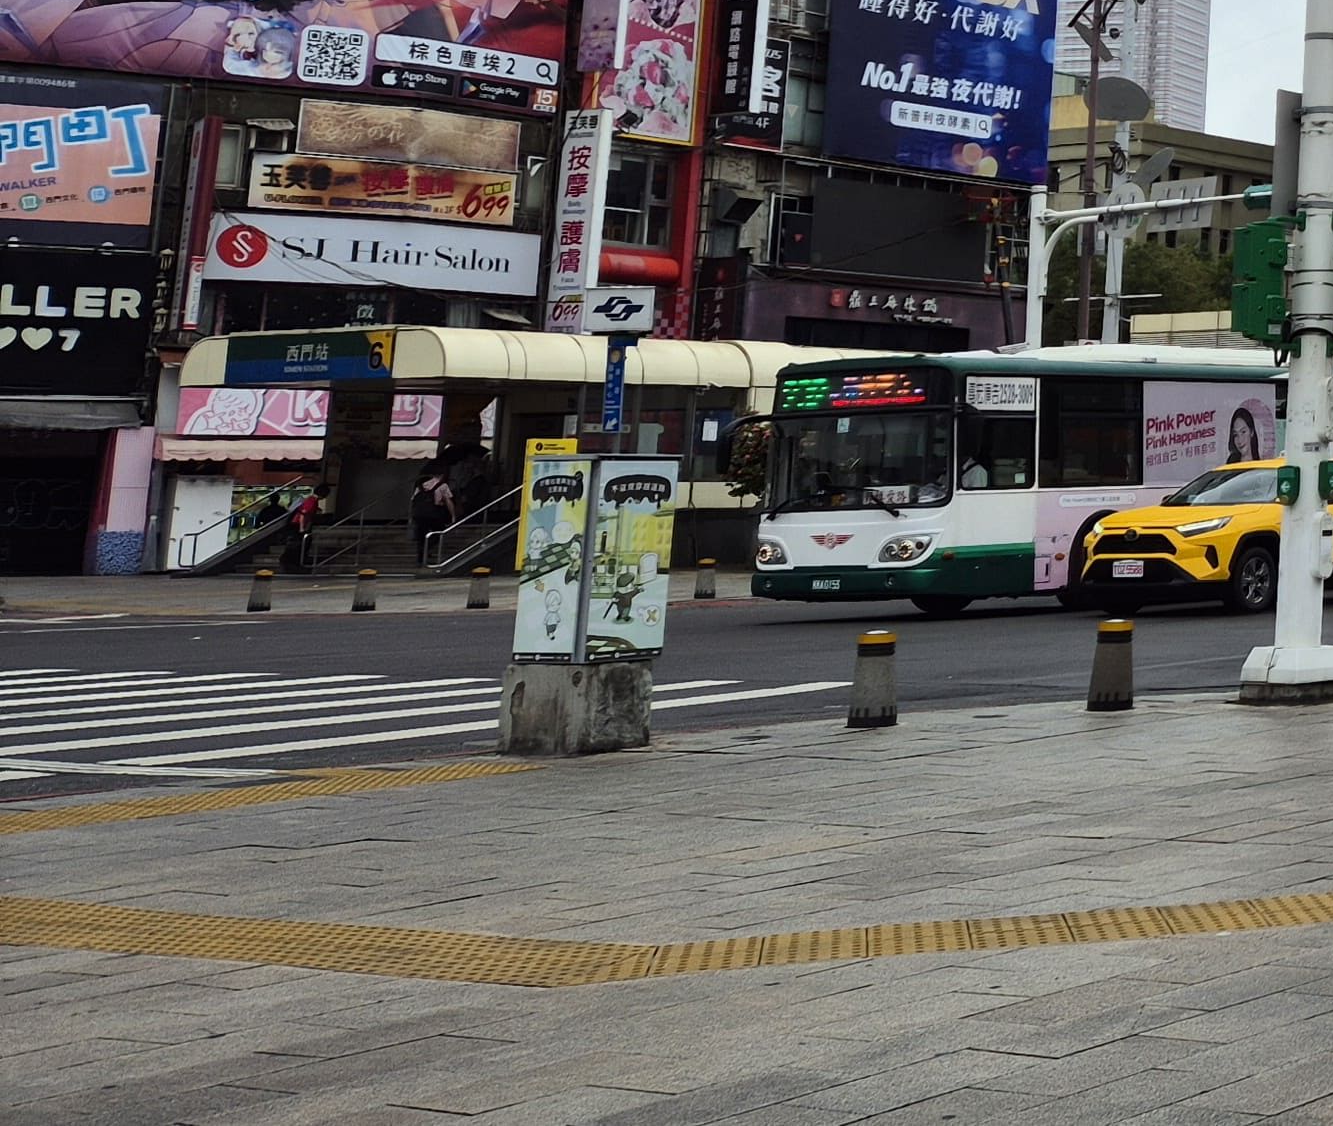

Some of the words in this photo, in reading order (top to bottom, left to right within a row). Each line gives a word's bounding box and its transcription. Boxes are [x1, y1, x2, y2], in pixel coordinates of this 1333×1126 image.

[408, 41, 516, 75] 棕色塵埃2
[402, 70, 424, 82] App
[425, 73, 448, 86] Store
[479, 82, 505, 95] Google
[505, 87, 521, 99] Play
[860, 60, 915, 93] No.1
[564, 145, 593, 199] 按摩
[281, 237, 327, 262] SJ
[349, 239, 430, 266] Hair
[433, 244, 511, 274] Salon
[556, 220, 585, 275] 護膚
[58, 327, 82, 353] 7
[285, 343, 329, 364] 西門站
[368, 341, 384, 371] 6
[1146, 414, 1175, 435] Pink
[1176, 408, 1216, 428] Power
[1146, 433, 1168, 451] Pink
[1168, 425, 1217, 445] Happiness
